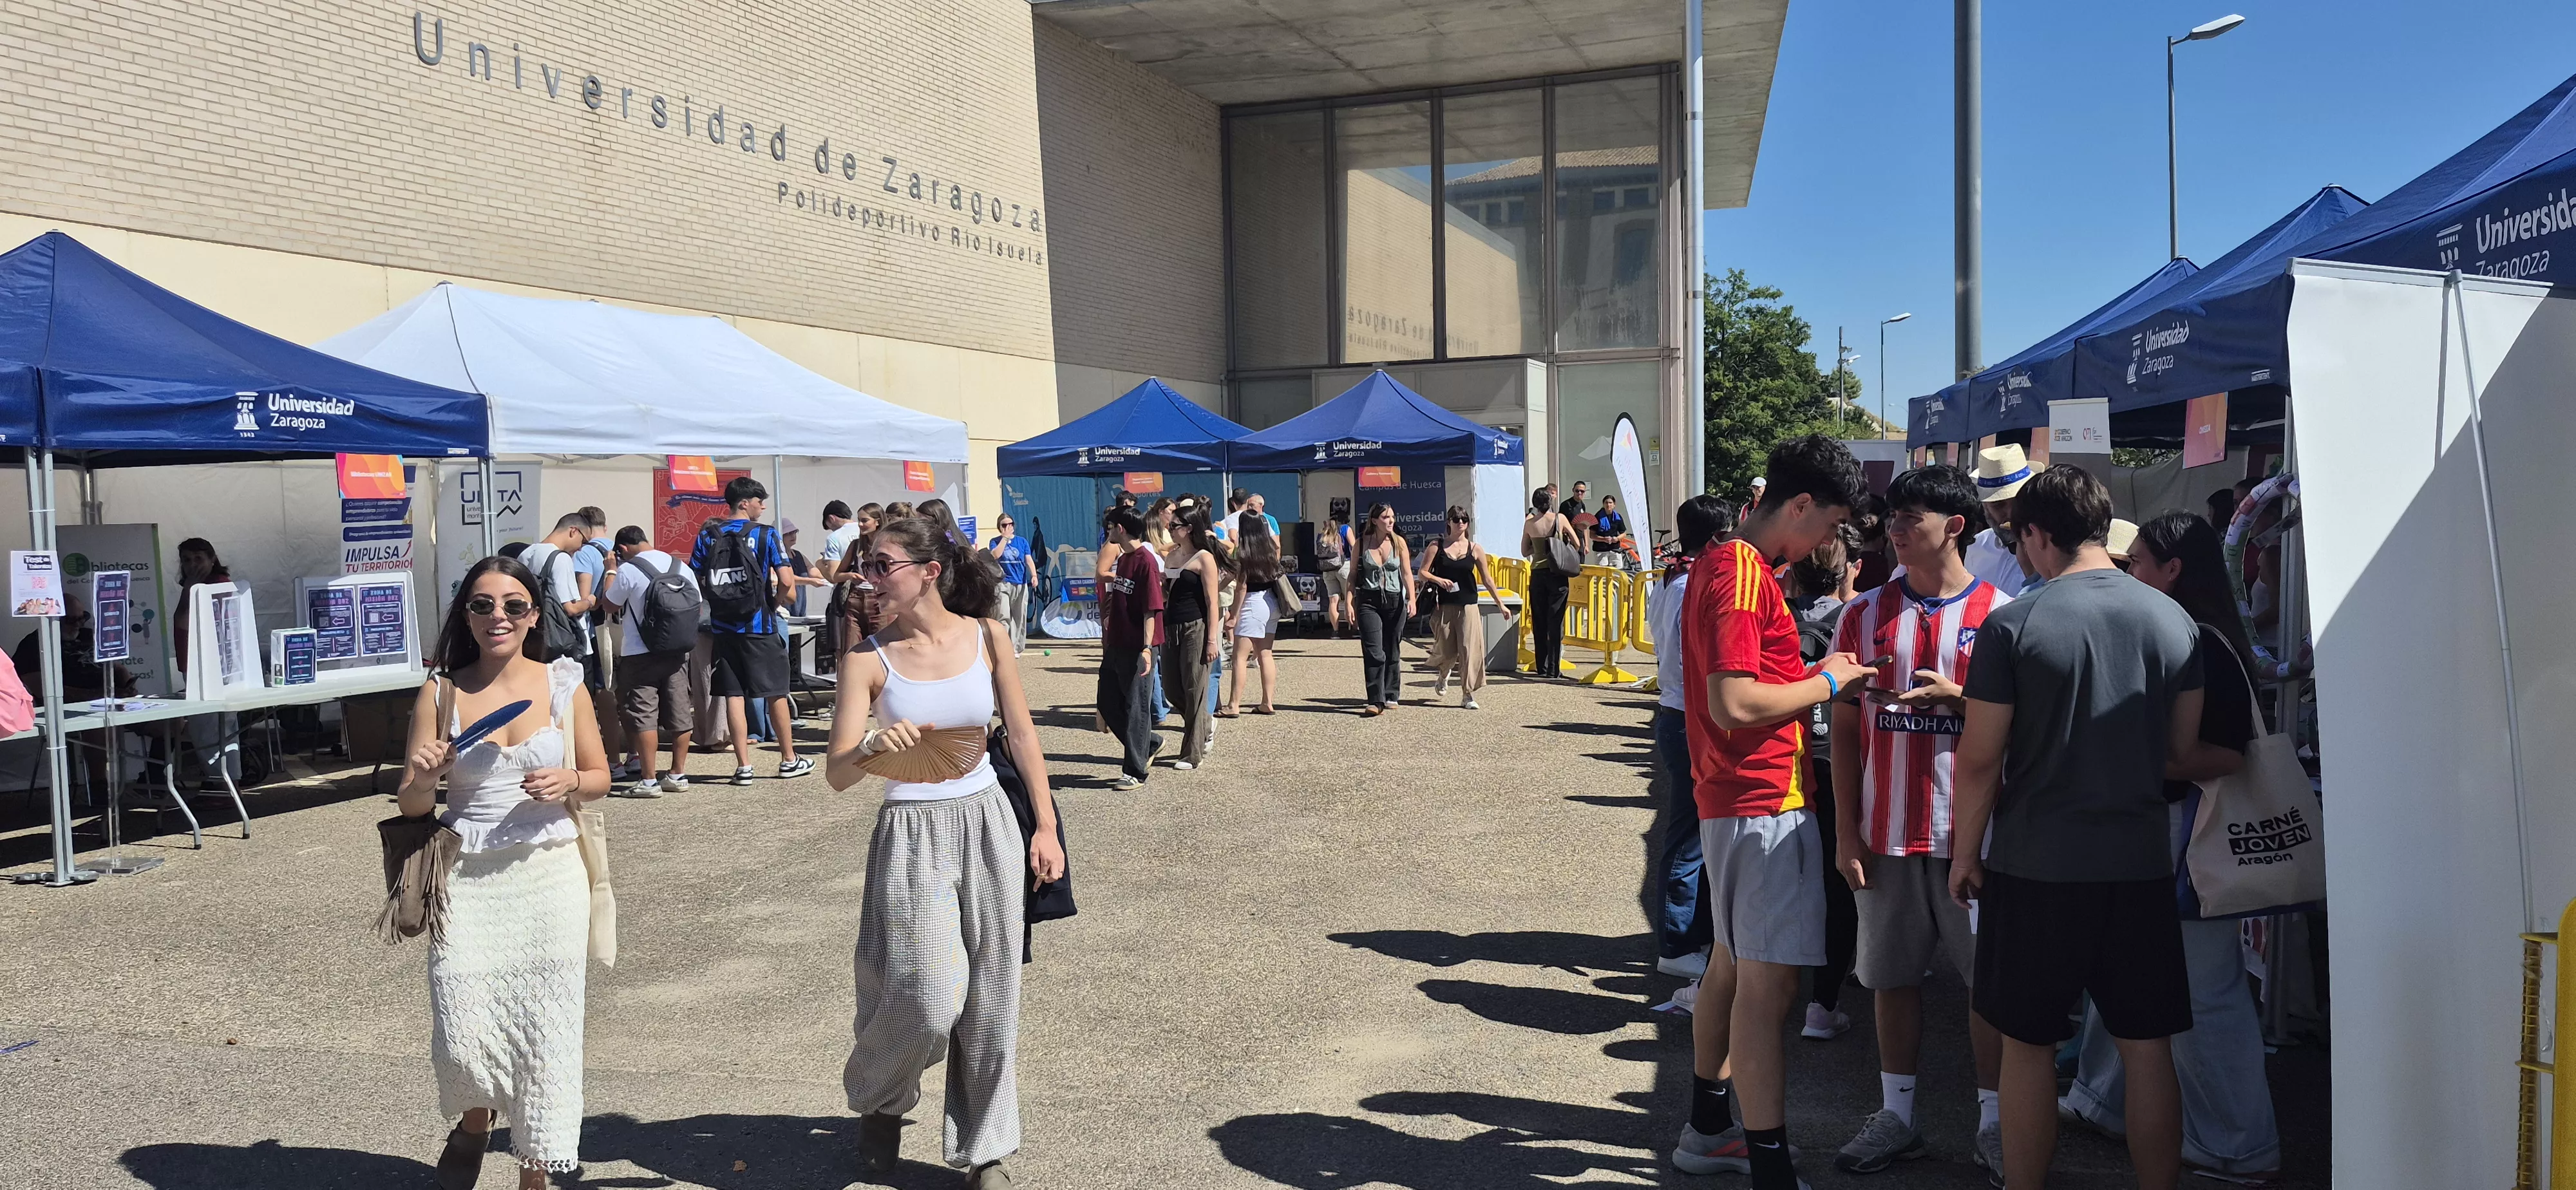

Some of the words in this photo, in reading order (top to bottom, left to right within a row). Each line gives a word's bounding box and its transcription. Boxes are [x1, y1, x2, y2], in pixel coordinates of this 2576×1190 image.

[414, 12, 787, 162] Universidad
[815, 137, 857, 180] de
[882, 156, 1041, 232] Zaragoza
[778, 181, 940, 241] Polideportivo
[989, 236, 1043, 265] Isuela
[2476, 250, 2550, 279] Zaragoza
[2145, 319, 2190, 354] Universidad
[2142, 355, 2174, 375] Zaragoza
[268, 393, 355, 416] Universidad
[270, 413, 326, 431] Zaragoza
[1095, 447, 1141, 456] Universidad
[1332, 440, 1383, 450] Universidad
[1333, 449, 1365, 458] Zaragoza
[1095, 455, 1124, 464] Zaragoza
[1410, 480, 1442, 489] Huesca
[460, 489, 522, 503] UTA
[1396, 511, 1444, 523] iversidad
[345, 545, 400, 562] IMPULSA
[346, 563, 359, 573] TU
[710, 566, 748, 586] VANS
[1879, 714, 1937, 730] RIYADH
[2227, 806, 2303, 836] CARNÉ
[2235, 826, 2311, 853] JOVEN
[2237, 853, 2293, 866] Aragón
